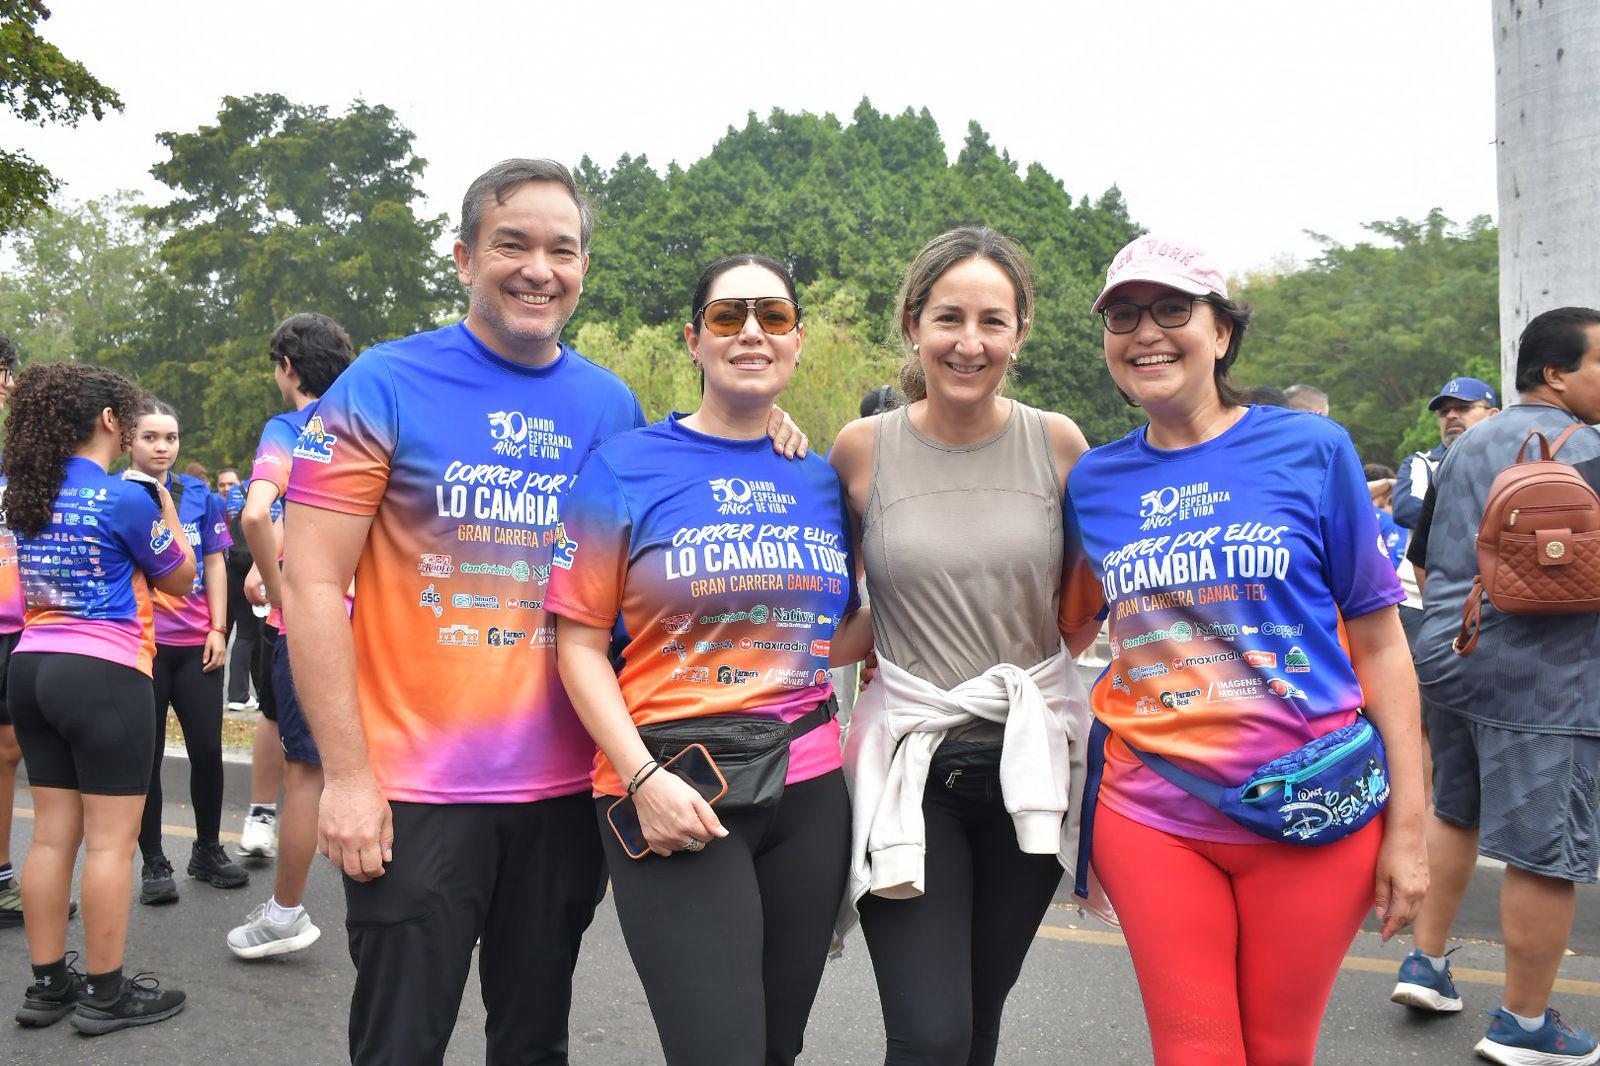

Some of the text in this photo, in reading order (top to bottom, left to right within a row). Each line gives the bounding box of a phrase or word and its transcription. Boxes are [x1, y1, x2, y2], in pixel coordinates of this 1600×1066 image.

[487, 411, 528, 444] 30
[528, 417, 555, 433] DANDO
[492, 439, 527, 459] AÑOS
[528, 432, 573, 450] ESPERANZA
[529, 446, 560, 460] DE VIDA
[444, 460, 523, 489] CORRER
[522, 472, 568, 494] POR
[750, 480, 776, 492] DANDO
[709, 478, 751, 504] 30
[752, 492, 797, 505] ESPERANZA
[1179, 482, 1209, 498] DANDO
[436, 485, 559, 526] LO CAMBIA
[717, 501, 753, 515] AÑOS
[755, 502, 788, 514] DE VIDA
[1140, 486, 1180, 518] 30
[1179, 491, 1231, 509] ESPERANZA
[1179, 504, 1214, 521] DE VIDA
[1140, 512, 1176, 532] AÑOS
[457, 524, 491, 543] GRAN
[494, 528, 539, 549] CARRERA
[672, 523, 755, 548] CORRER
[758, 524, 799, 542] POR
[1102, 521, 1290, 571] CORRER POR ELLOS
[665, 542, 848, 581] LO CAMBIA TODO
[1102, 544, 1290, 604] LO CAMBIA TODO
[690, 574, 842, 598] GRAN CARRERA GANAC-TEC
[1143, 589, 1195, 612] CARRERA
[1198, 583, 1267, 605] GANAC-TEC
[772, 607, 816, 624] Nativa
[1195, 622, 1240, 637] Nativa
[1260, 622, 1304, 639] Coppel
[753, 639, 808, 652] maxiradio
[1175, 687, 1201, 699] Farmer's
